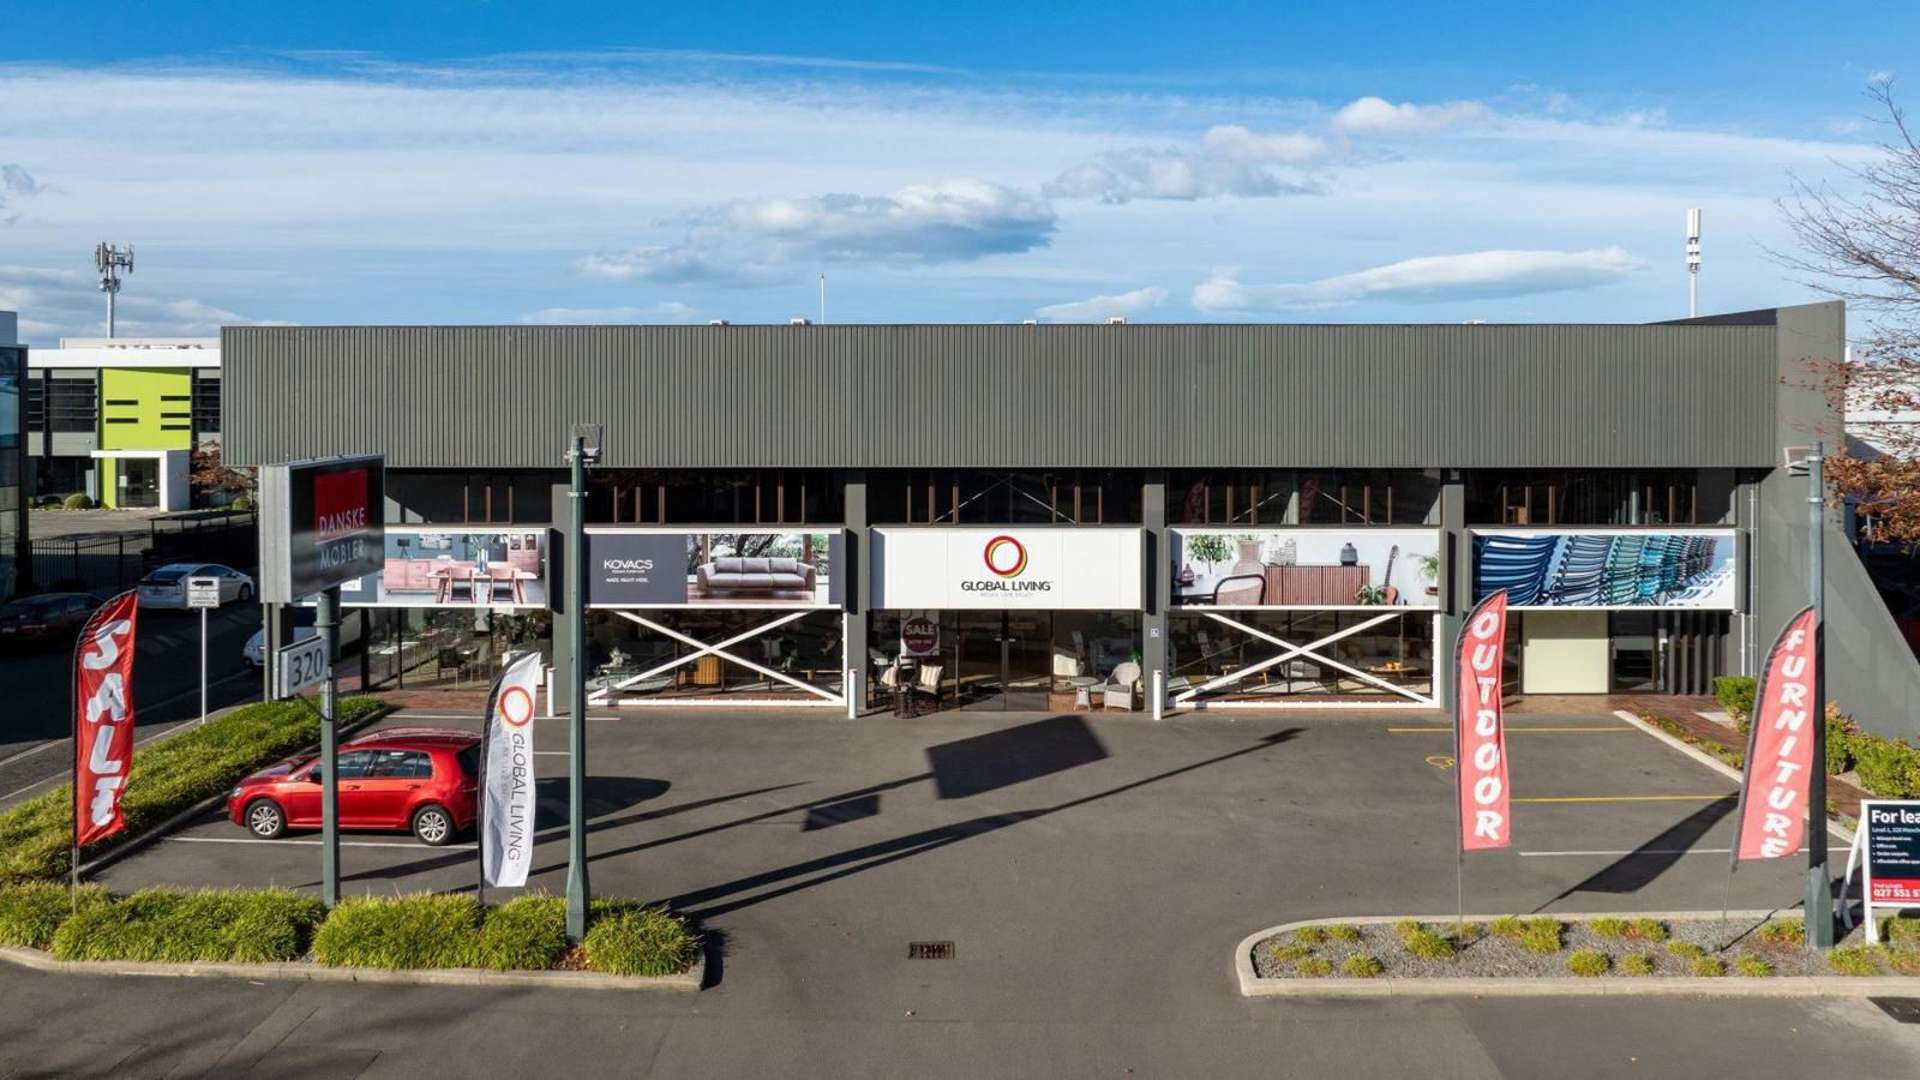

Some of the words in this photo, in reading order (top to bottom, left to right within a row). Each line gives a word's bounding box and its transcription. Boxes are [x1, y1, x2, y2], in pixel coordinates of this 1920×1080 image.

[320, 507, 365, 536] DANSKE
[604, 559, 654, 570] KOVACS
[961, 581, 1010, 592] GLOBAL
[1012, 581, 1051, 592] LIVING
[905, 624, 935, 636] SALE
[292, 648, 324, 687] 320
[1471, 611, 1503, 842] OUTDOOR
[1760, 629, 1808, 858] FURNITURE
[511, 733, 527, 800] GLOBAL
[508, 805, 525, 861] LIVING
[1872, 809, 1899, 823] For
